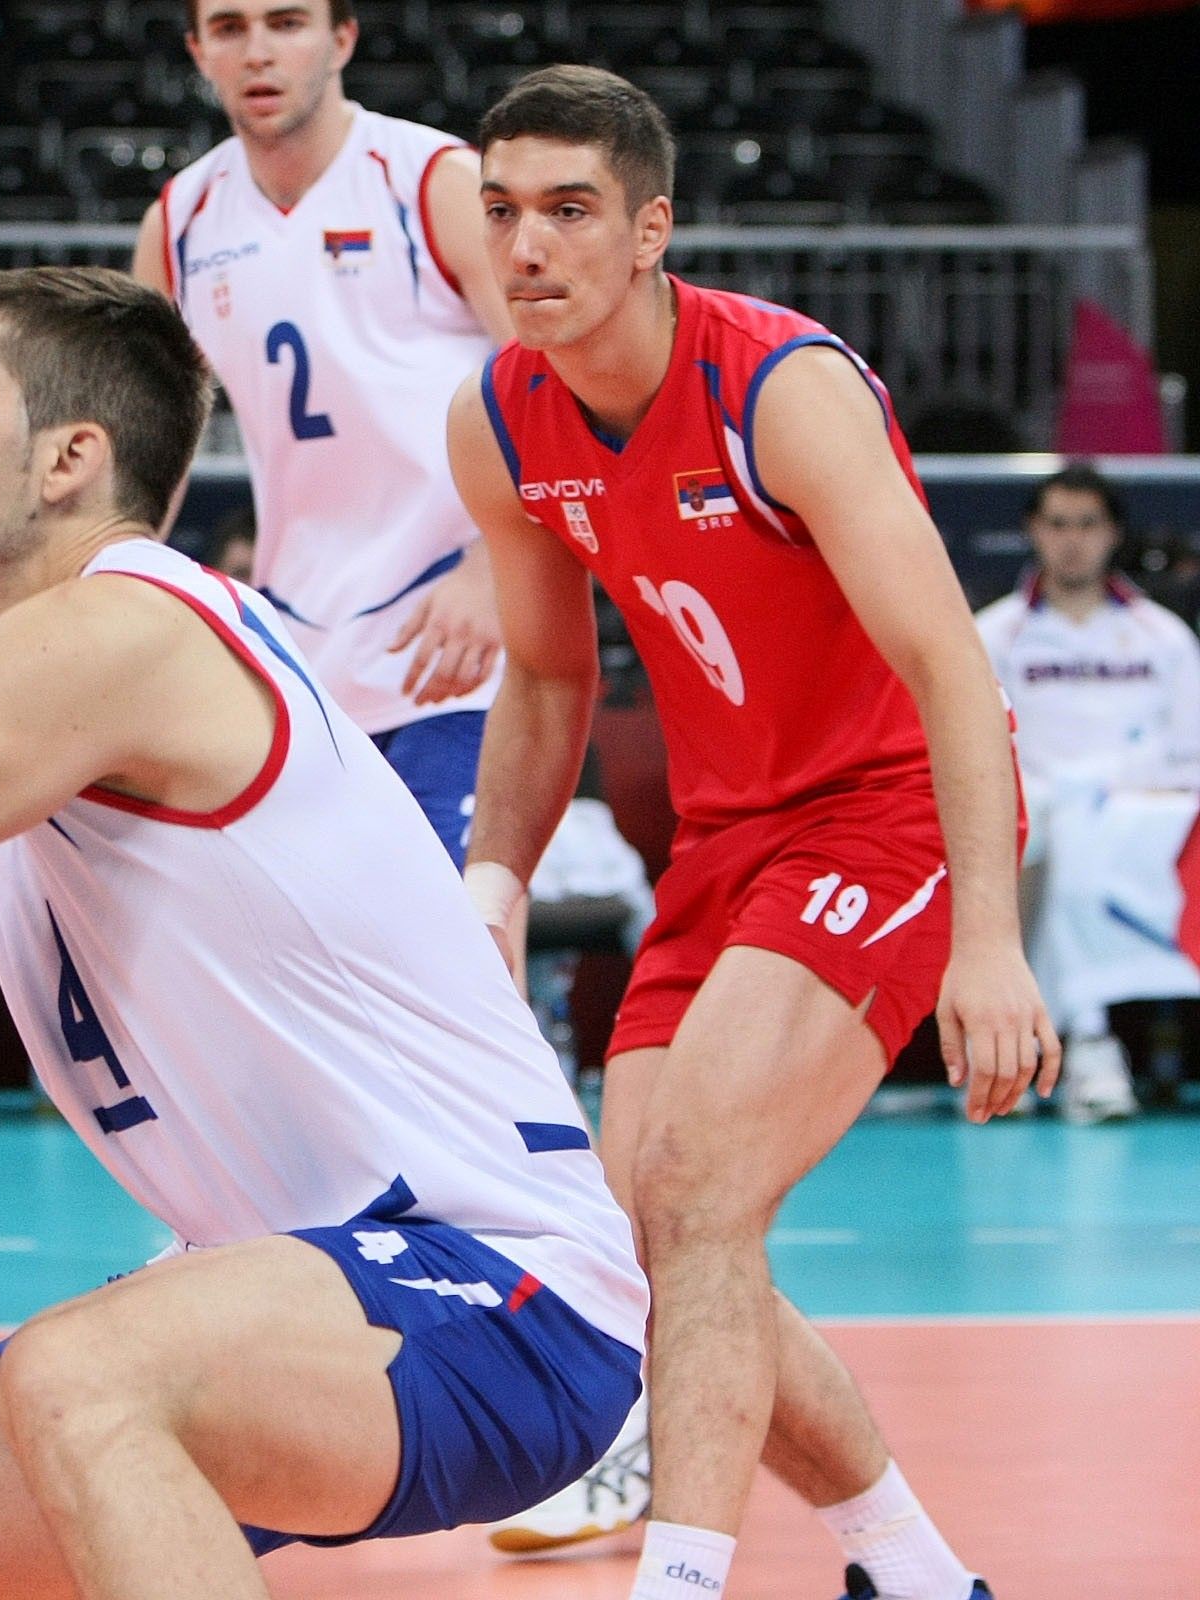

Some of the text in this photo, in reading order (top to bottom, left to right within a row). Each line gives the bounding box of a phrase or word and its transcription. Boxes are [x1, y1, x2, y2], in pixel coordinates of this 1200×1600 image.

[266, 320, 336, 441] 2
[697, 515, 734, 532] SRB
[800, 871, 869, 936] 19
[46, 899, 159, 1136] 4
[351, 1229, 409, 1265] 4
